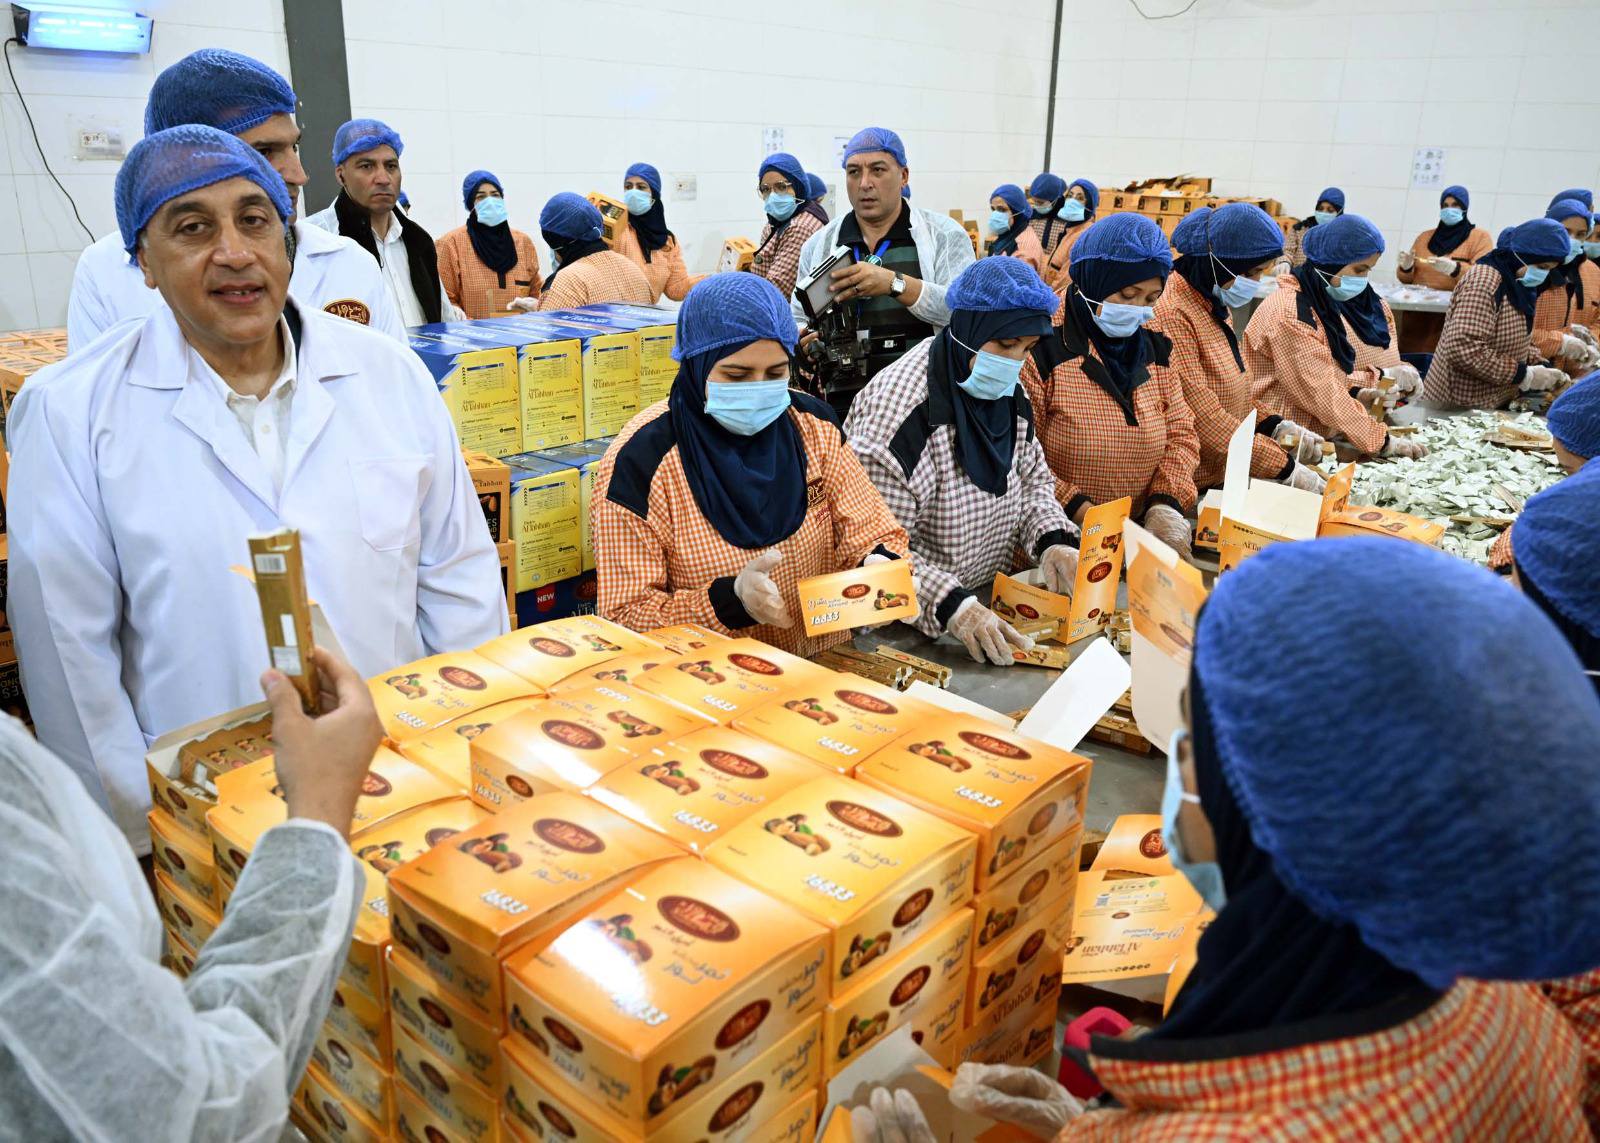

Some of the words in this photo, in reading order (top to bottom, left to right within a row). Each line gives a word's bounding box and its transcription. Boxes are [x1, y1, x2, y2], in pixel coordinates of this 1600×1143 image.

[537, 592, 555, 603] NEW
[811, 611, 840, 626] 16833
[815, 735, 860, 756] 16833
[954, 785, 1004, 808] 16833
[673, 809, 721, 834] 16833
[805, 873, 856, 902] 16833
[482, 888, 530, 914] 16833
